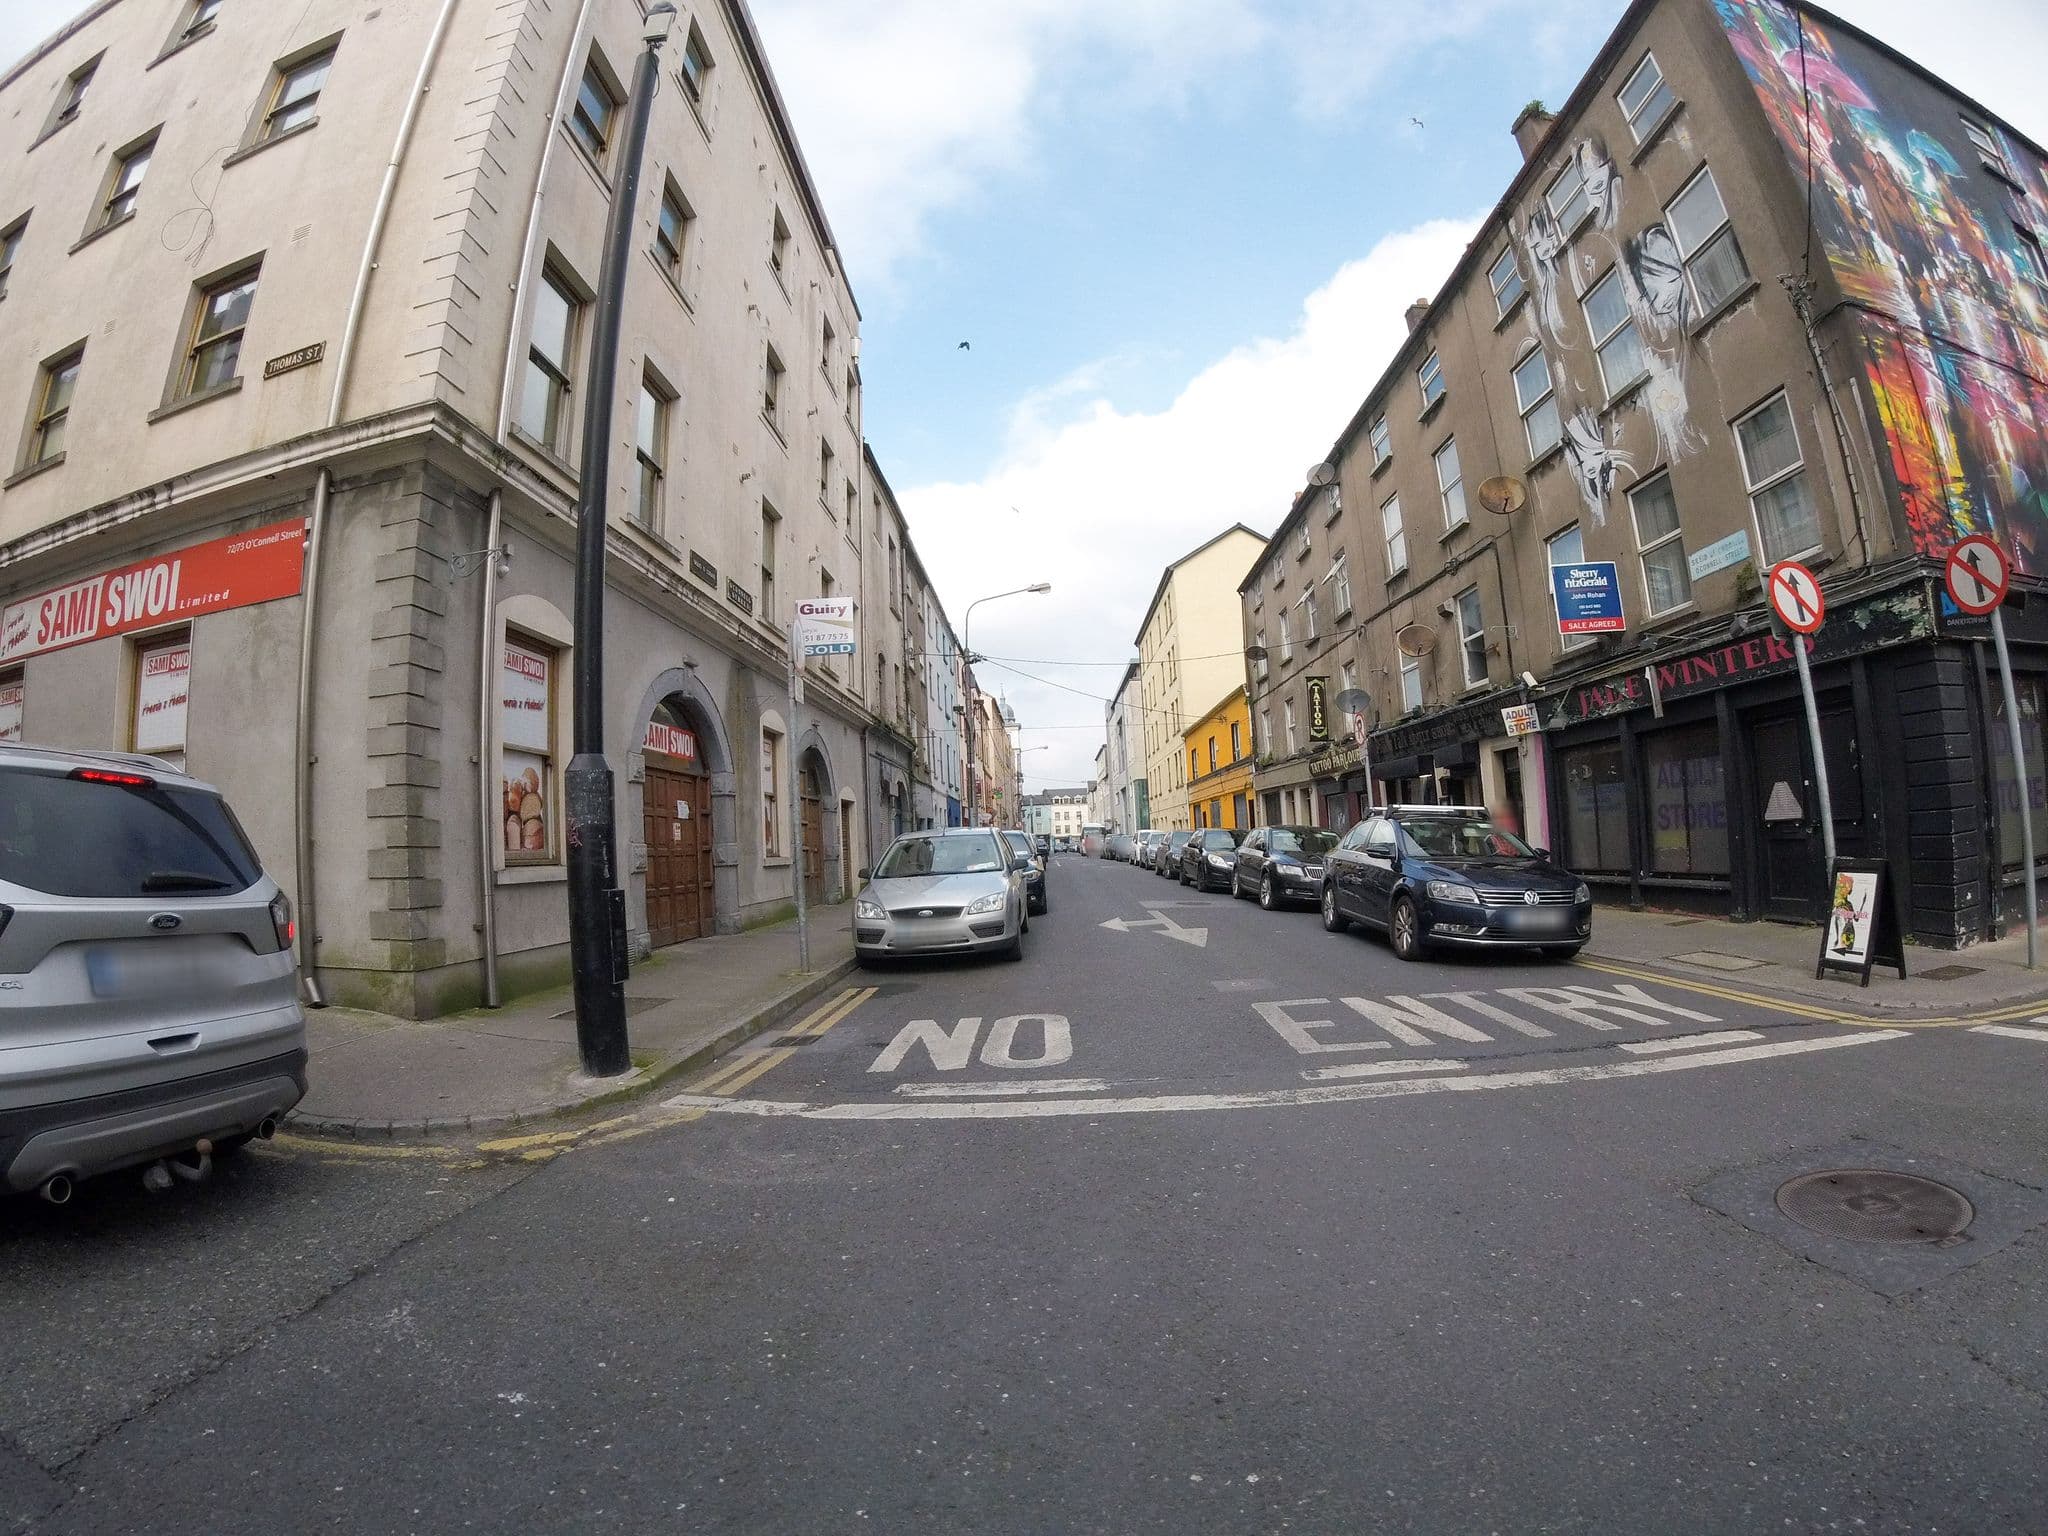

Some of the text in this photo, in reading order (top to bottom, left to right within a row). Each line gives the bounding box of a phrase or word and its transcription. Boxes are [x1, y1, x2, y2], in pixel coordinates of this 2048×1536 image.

[269, 346, 319, 372] THOMAS ST
[227, 528, 302, 554] 72/73 O'Connell Street
[1564, 577, 1608, 588] FitzGerald
[1570, 569, 1598, 579] Sherry
[37, 584, 99, 645] SAMI
[105, 560, 181, 627] SWOI
[180, 590, 230, 609] Limited
[800, 604, 848, 617] Guiry
[1569, 620, 1617, 630] SALE AGREED
[828, 633, 837, 641] 75
[840, 632, 849, 640] 75
[805, 644, 852, 656] SOLD
[149, 656, 169, 673] SAMI
[524, 658, 543, 678] SWOI
[1655, 635, 1816, 690] WINTERS
[1312, 685, 1322, 726] TATTOO
[1505, 704, 1535, 720] ADULT
[1508, 720, 1537, 733] STORE
[670, 730, 694, 757] SWOI
[1310, 757, 1332, 774] TATTOO
[1252, 983, 1723, 1053] ENTRY
[865, 1013, 1073, 1072] NO
